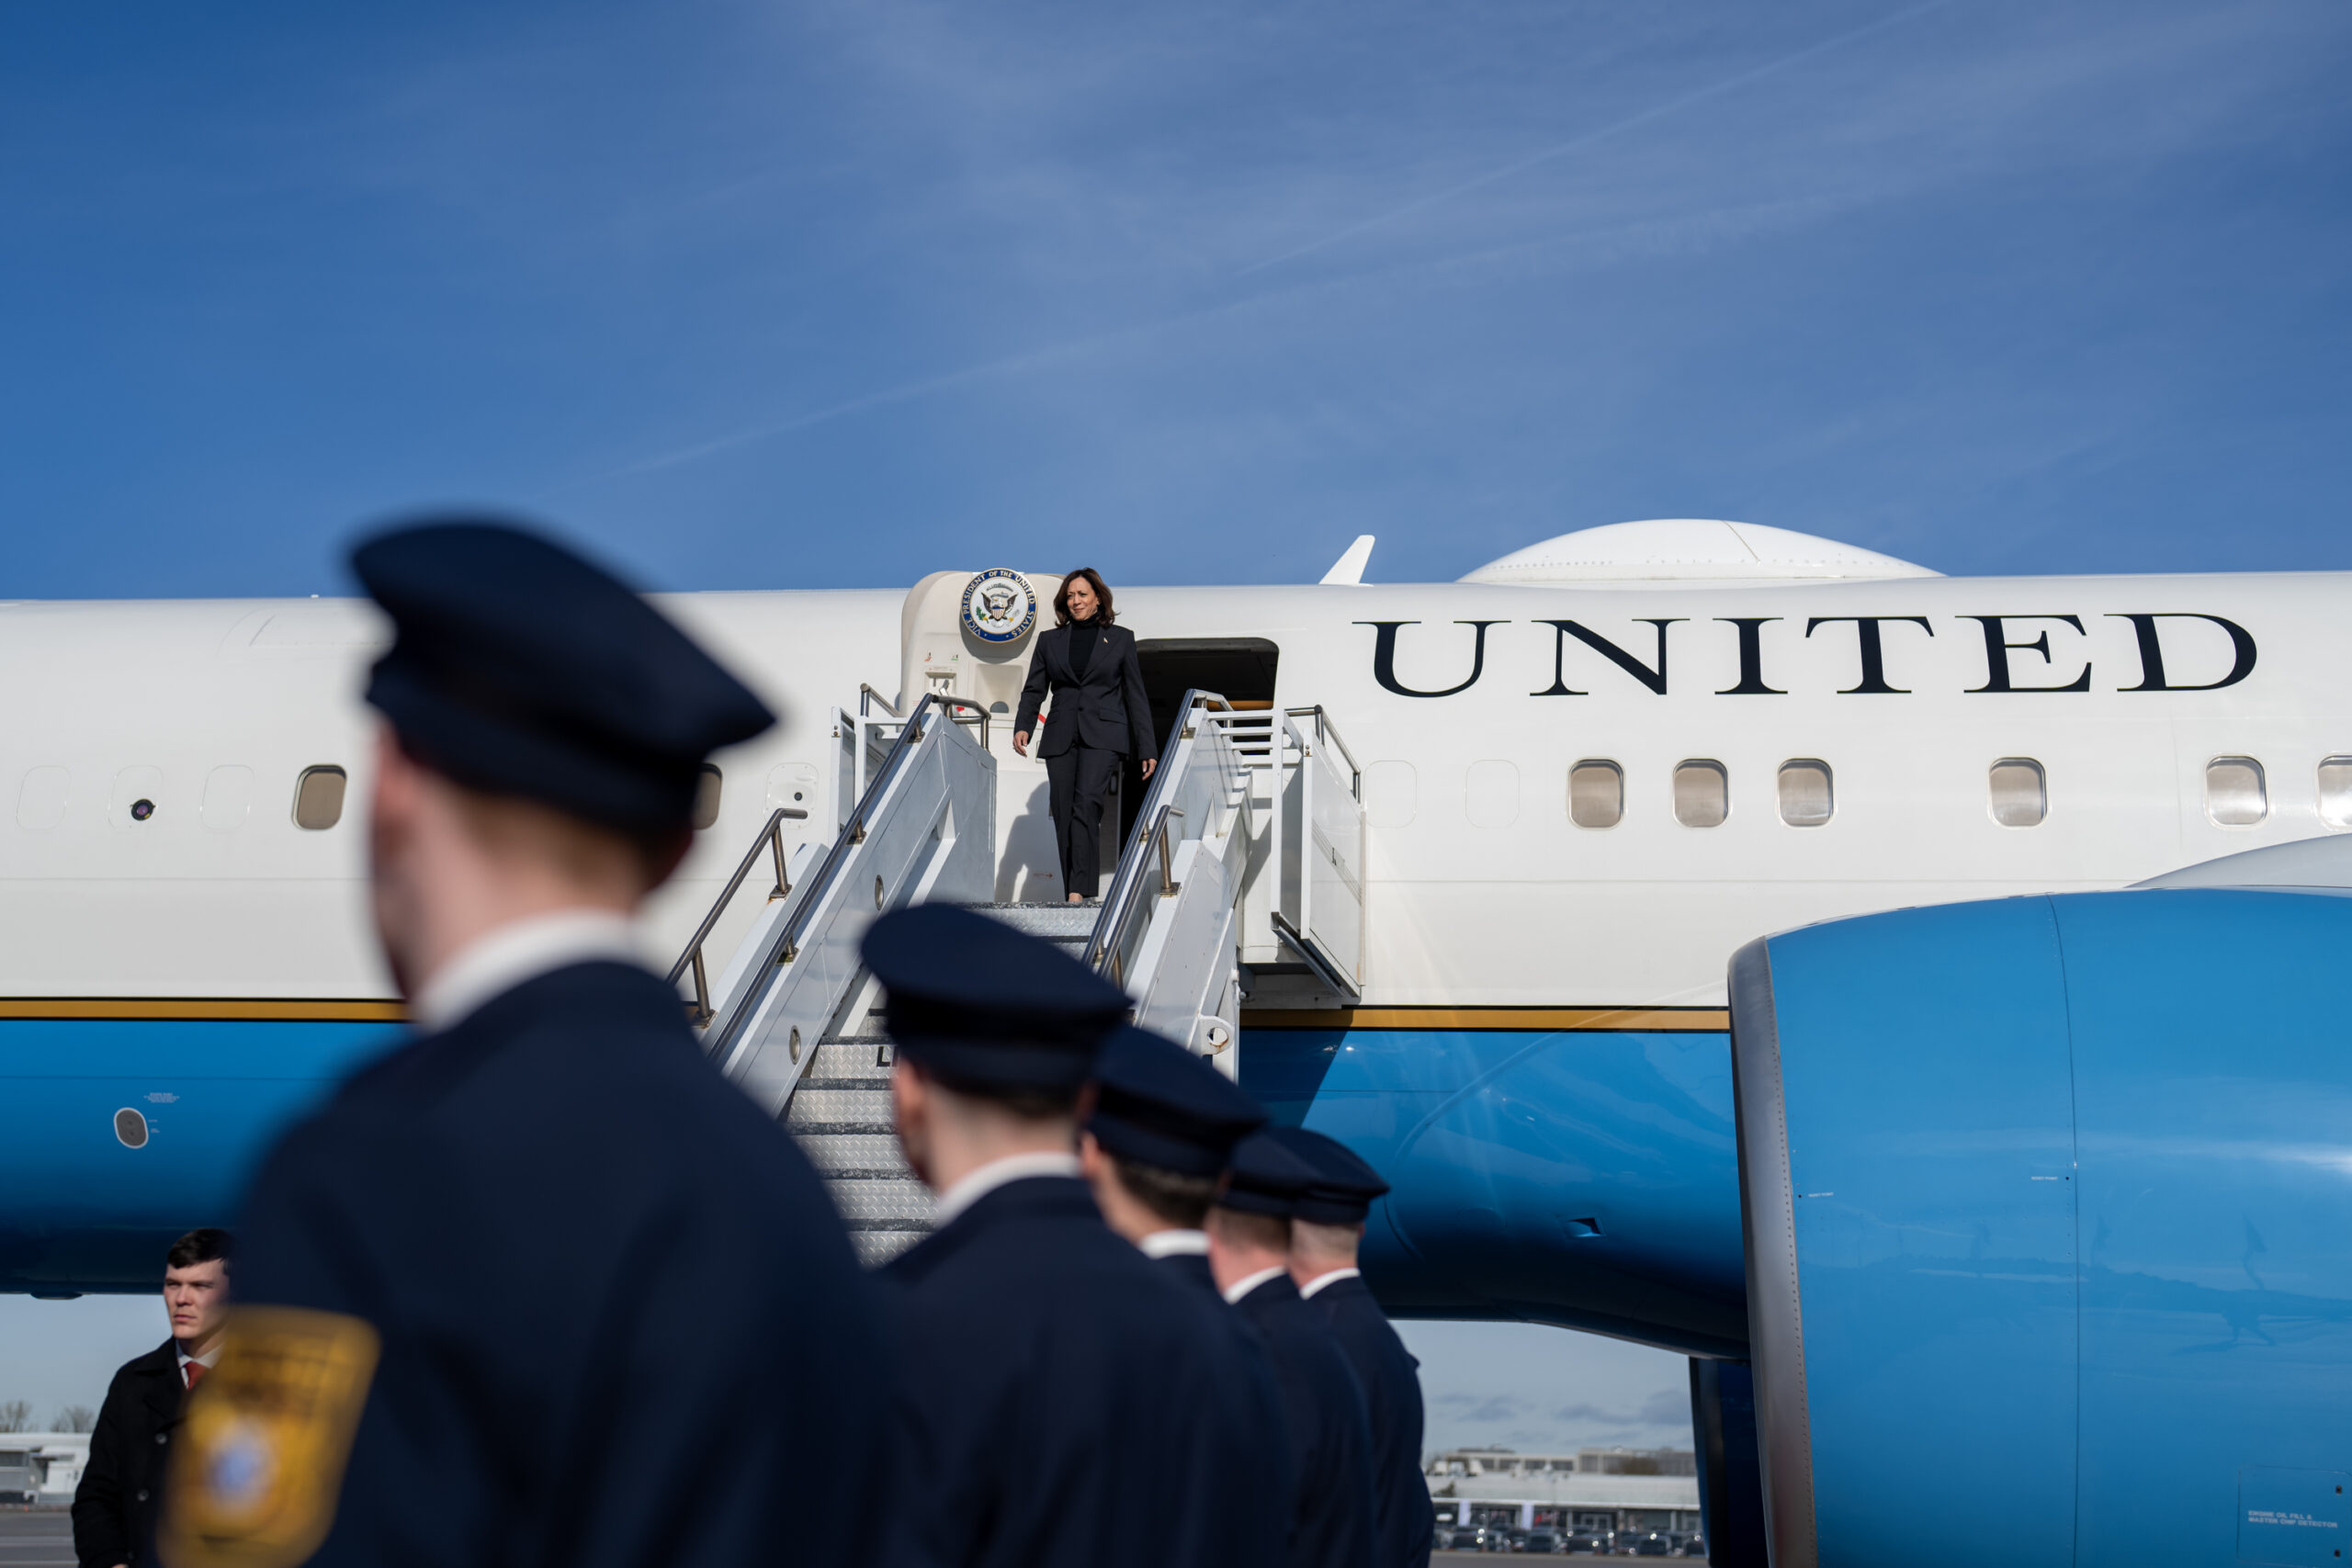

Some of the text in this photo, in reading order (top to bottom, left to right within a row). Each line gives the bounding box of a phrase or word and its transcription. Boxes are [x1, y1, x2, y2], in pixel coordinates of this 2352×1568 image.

[963, 573, 986, 615] PRESIDENT
[1014, 575, 1035, 604] UNITED
[966, 617, 981, 636] VICE
[1012, 611, 1035, 637] STATES
[1351, 614, 2257, 698] UNITED
[2298, 1519, 2338, 1529] DETECTOR
